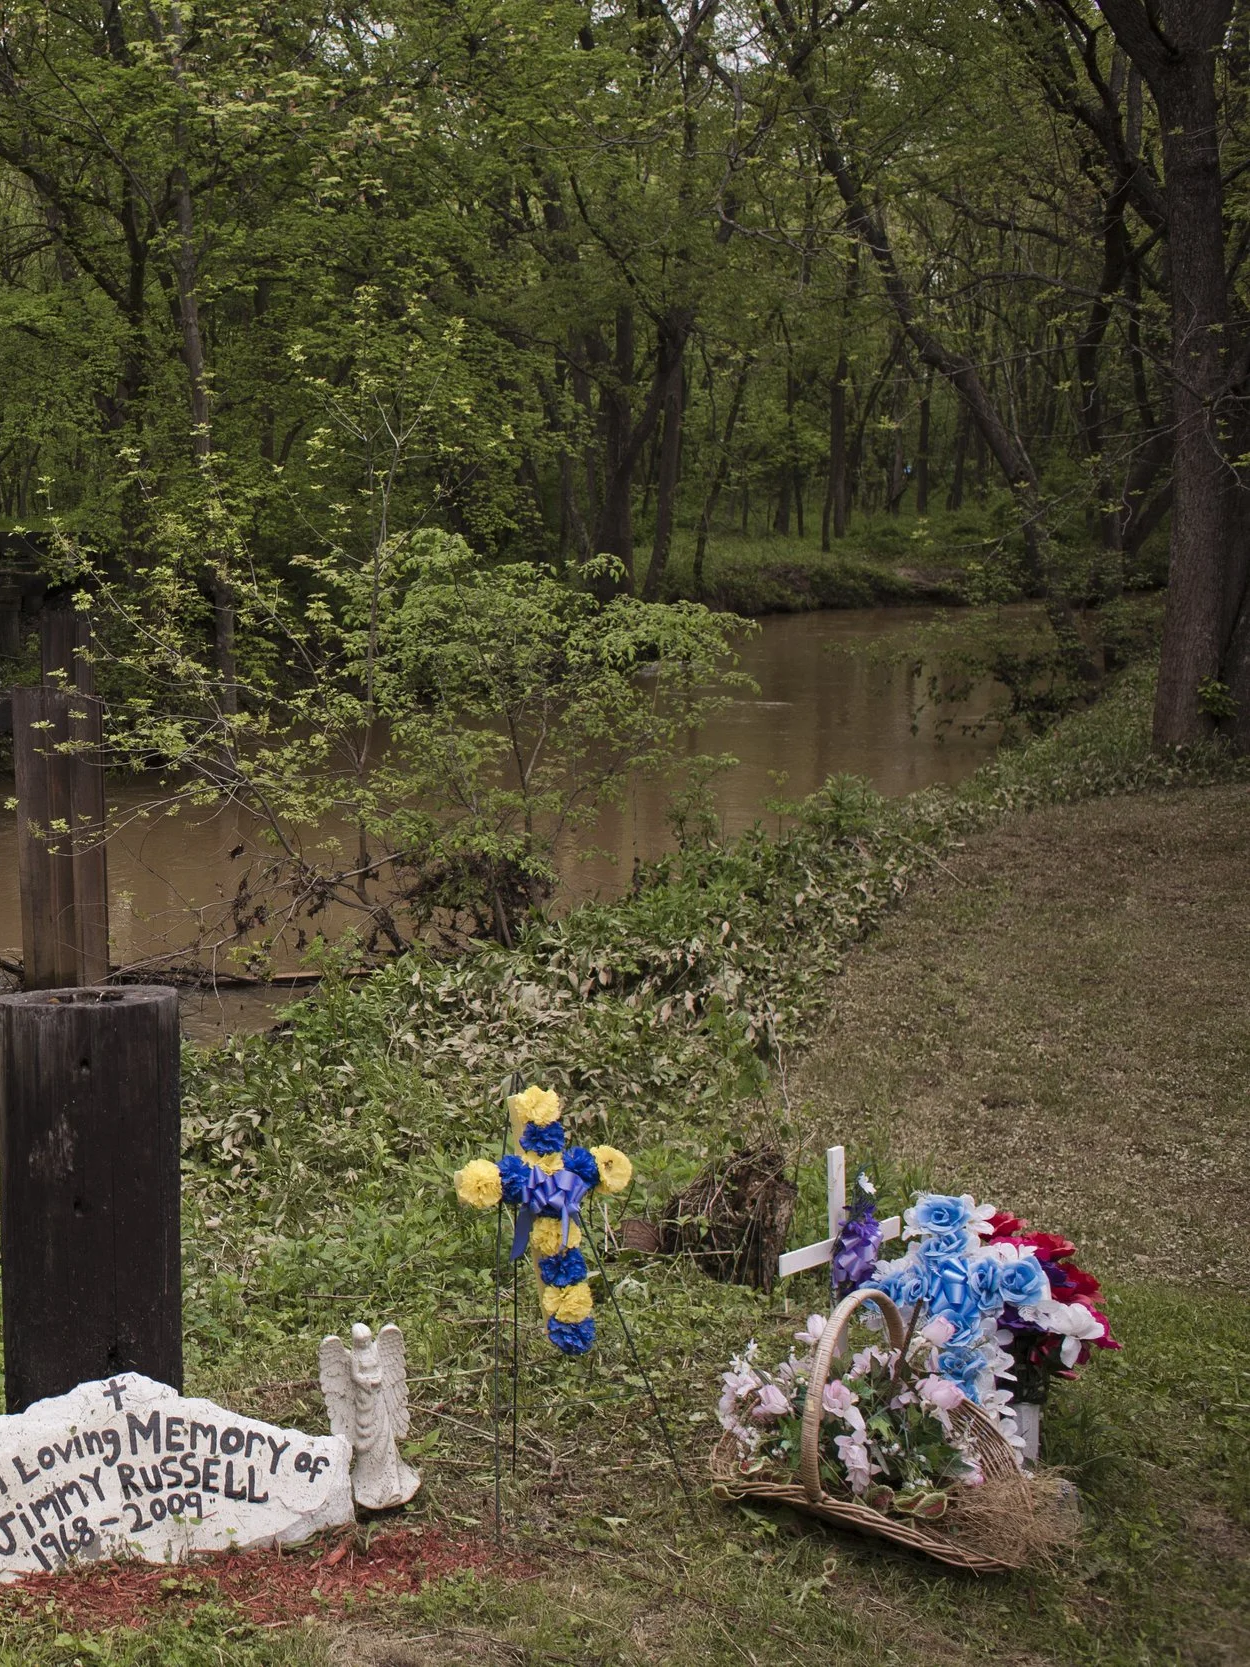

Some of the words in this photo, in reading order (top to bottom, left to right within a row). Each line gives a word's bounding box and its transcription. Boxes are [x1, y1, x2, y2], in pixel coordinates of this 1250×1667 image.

[12, 1428, 121, 1484] Loving
[294, 1451, 330, 1483] of
[117, 1452, 269, 1504] RUSSELL
